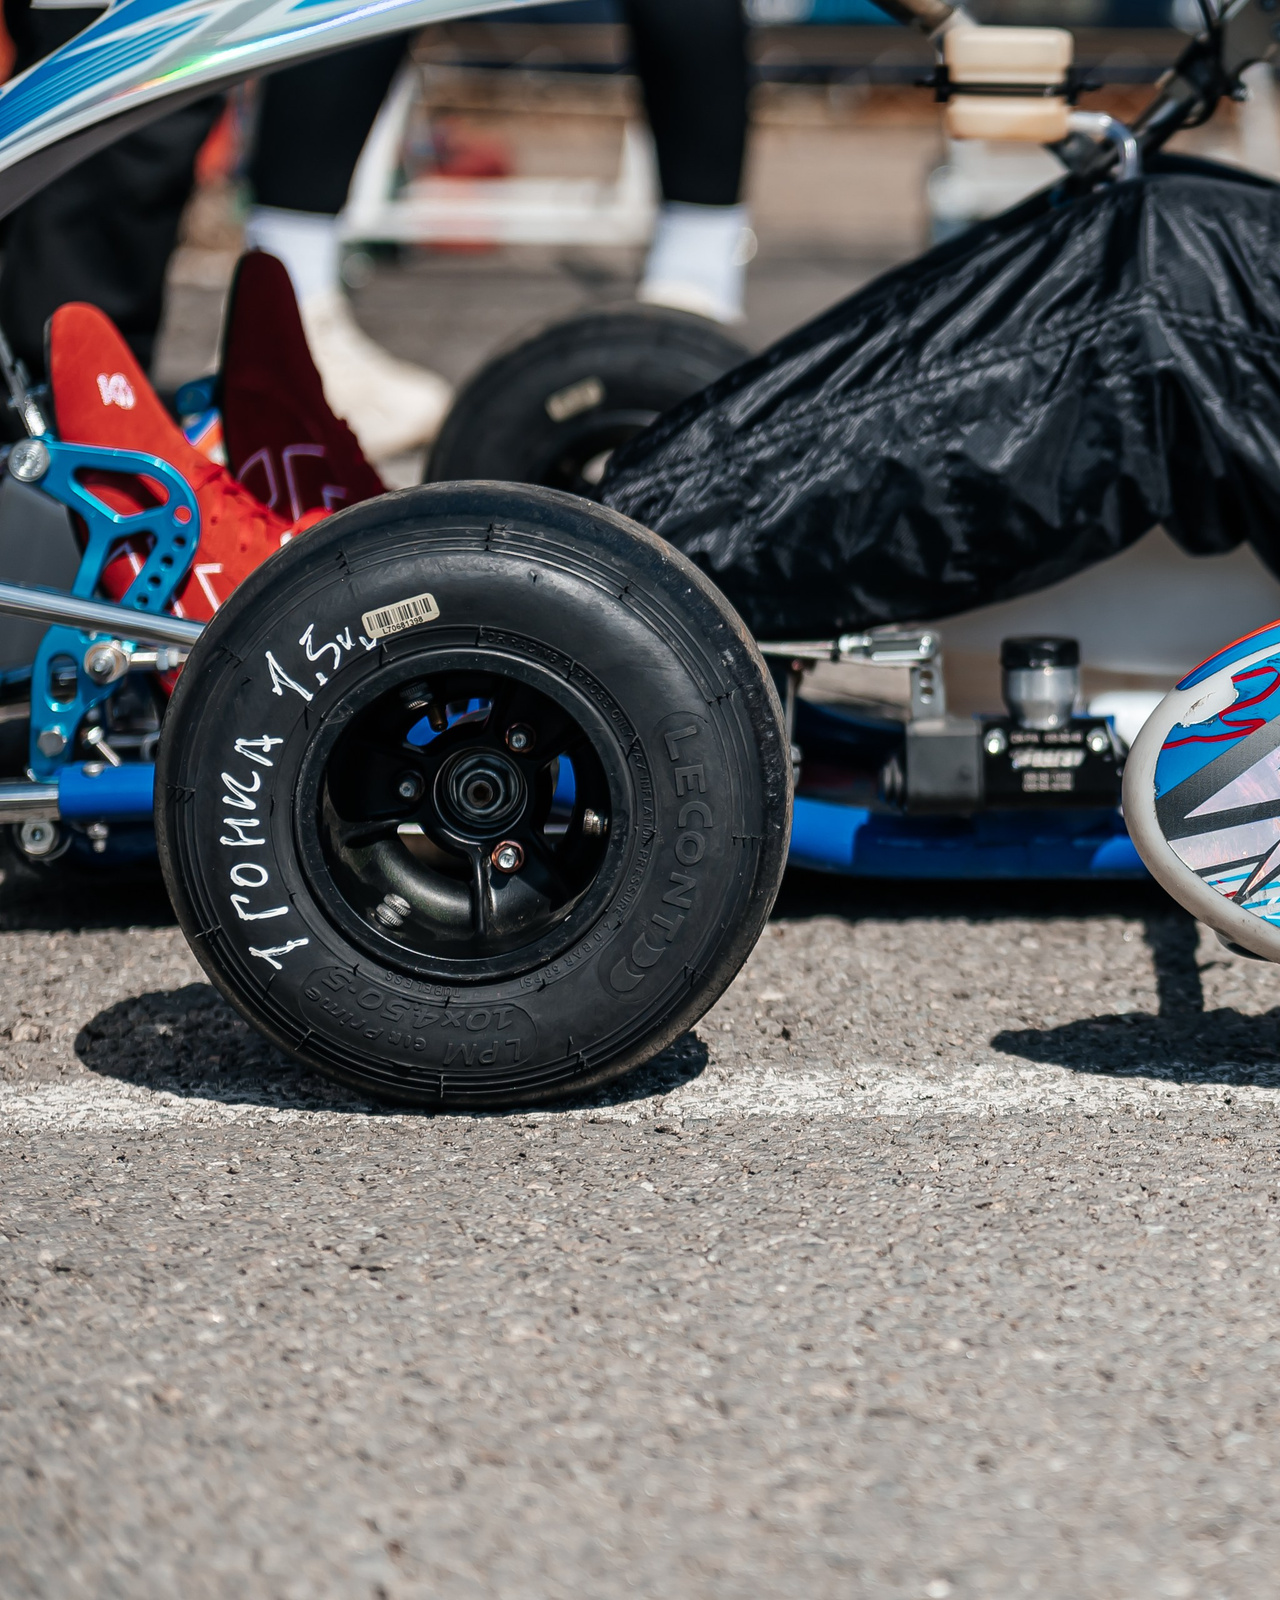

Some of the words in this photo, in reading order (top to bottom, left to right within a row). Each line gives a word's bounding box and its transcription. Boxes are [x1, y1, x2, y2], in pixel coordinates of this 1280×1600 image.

[384, 970, 461, 998] TUBELESS
[304, 985, 385, 1040] Prime
[442, 1037, 521, 1068] LPM
